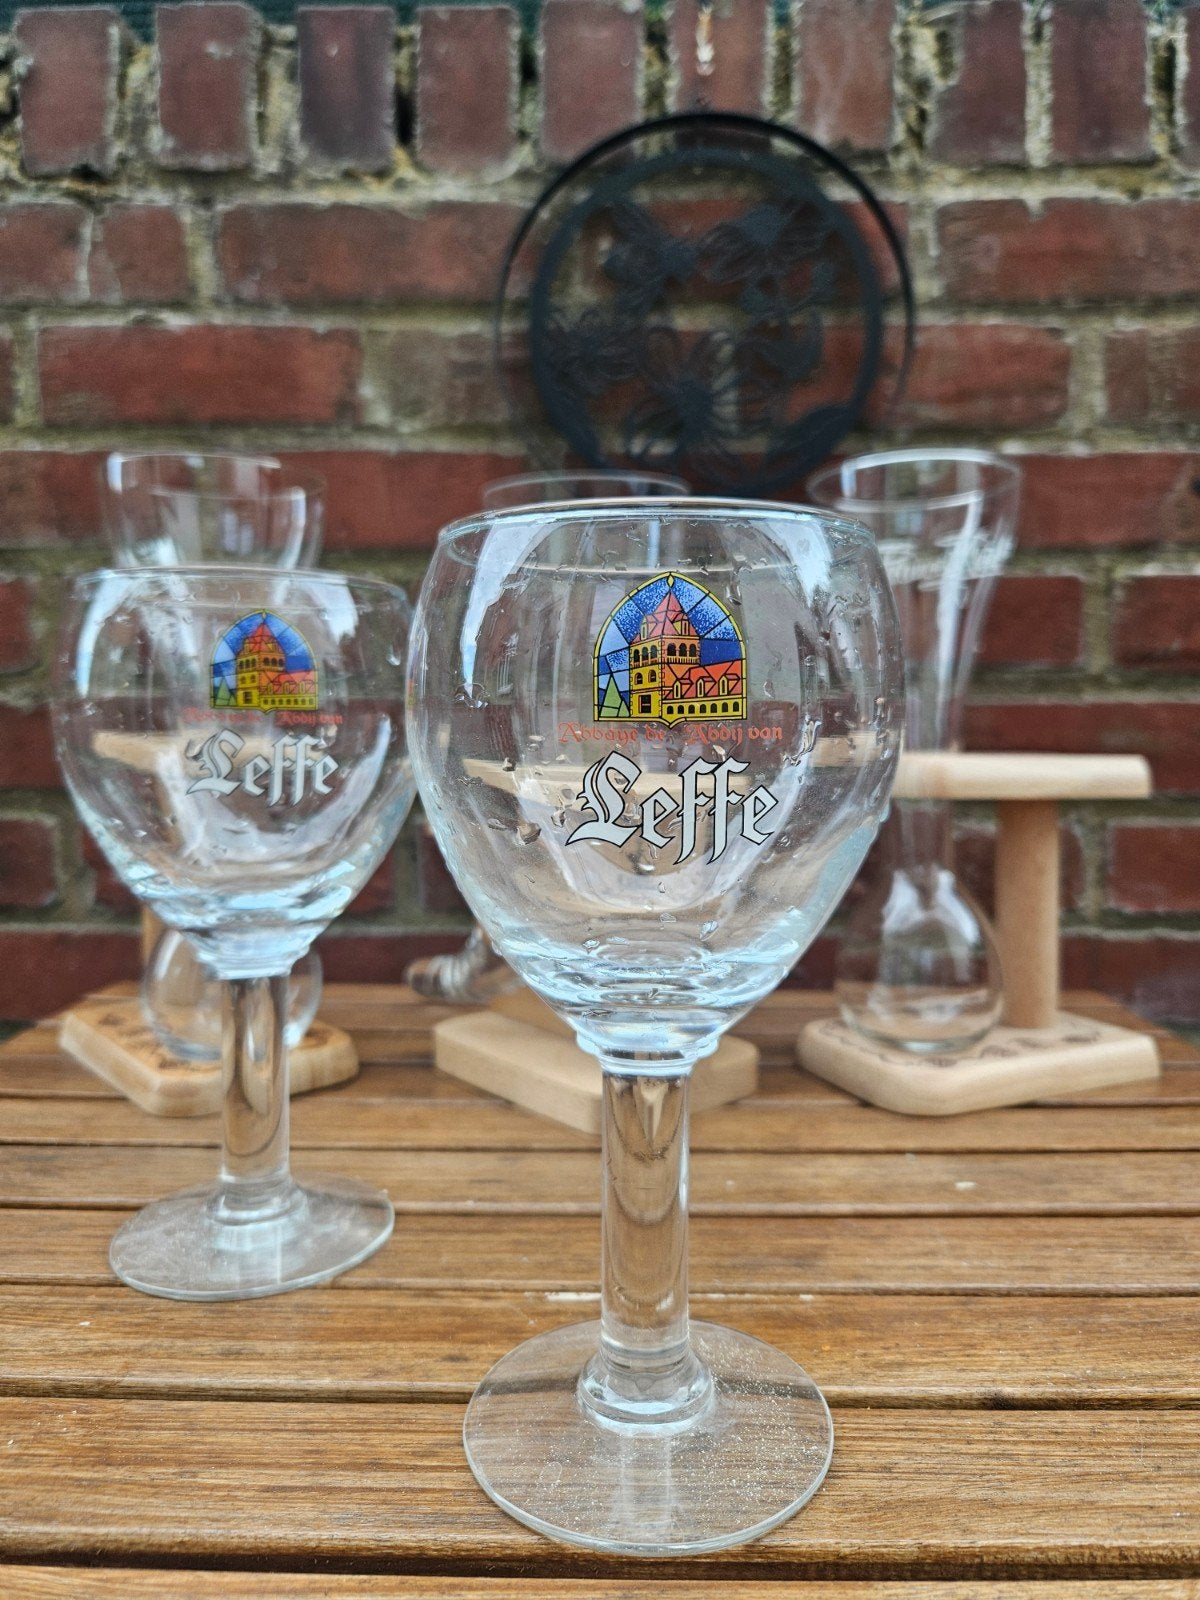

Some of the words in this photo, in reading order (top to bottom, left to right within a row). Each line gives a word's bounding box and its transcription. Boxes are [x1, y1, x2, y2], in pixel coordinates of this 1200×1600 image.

[187, 729, 339, 806] Leffe
[559, 721, 638, 746] Abbaye
[645, 723, 666, 742] de
[684, 723, 743, 746] Abdij
[748, 726, 783, 740] van
[566, 751, 778, 864] Leffe
